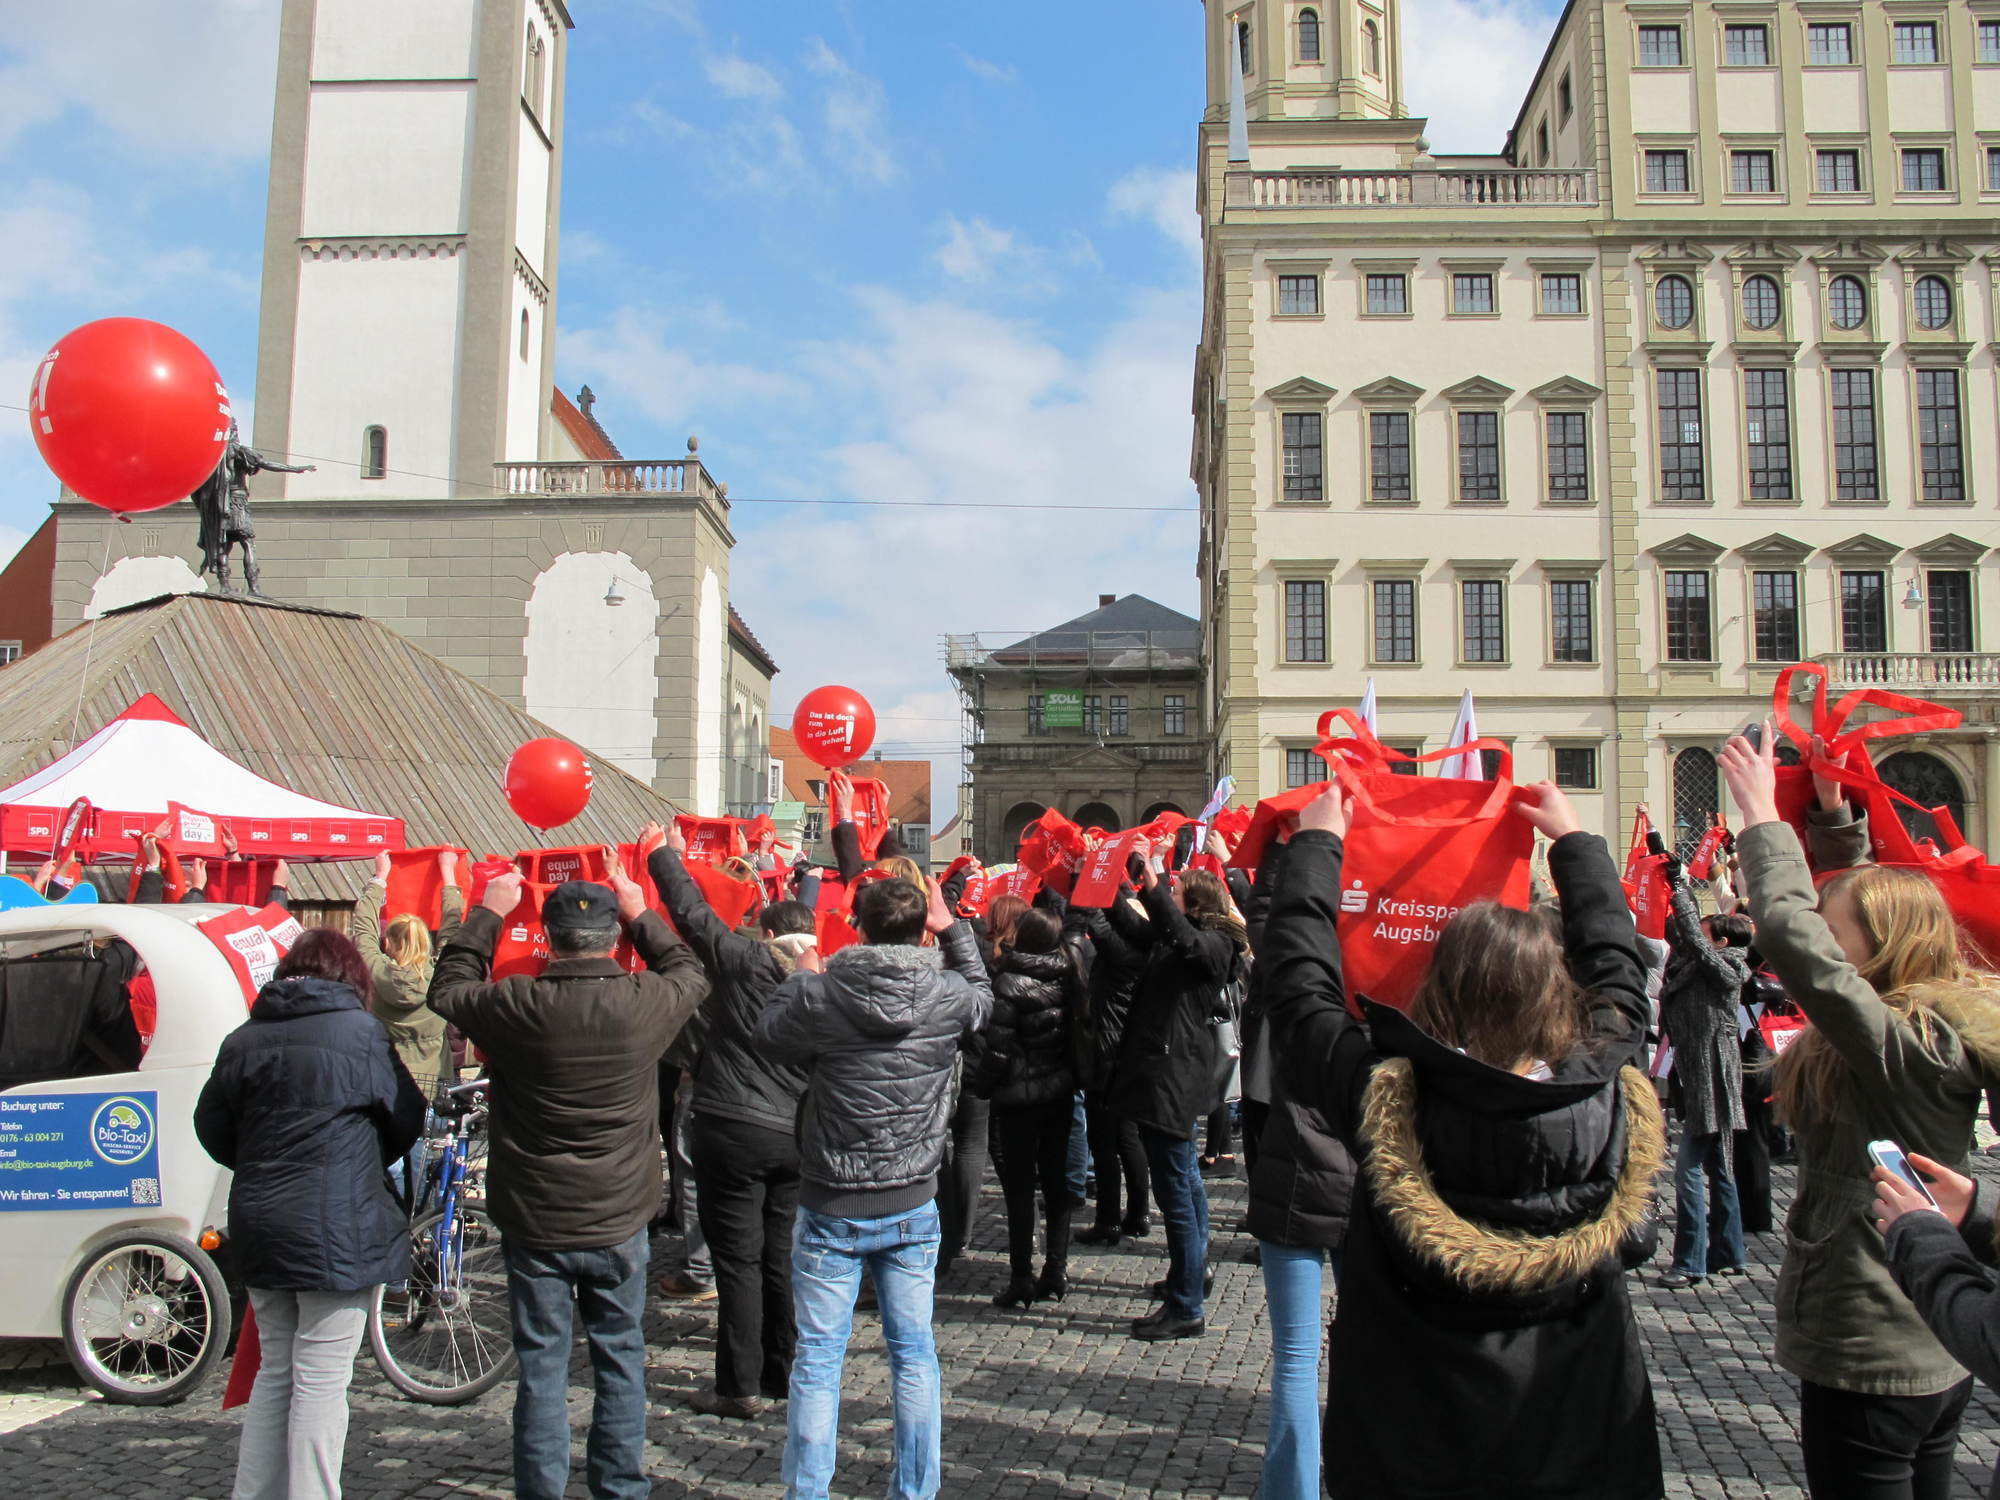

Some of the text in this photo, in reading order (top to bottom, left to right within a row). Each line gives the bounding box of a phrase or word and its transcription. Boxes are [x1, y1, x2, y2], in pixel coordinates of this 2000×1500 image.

[1047, 694, 1081, 704] SOLL
[829, 727, 845, 736] Luft
[30, 827, 50, 836] SPD
[252, 831, 269, 840] SPD
[292, 832, 309, 841] SPD
[330, 834, 347, 842] SPD
[367, 834, 384, 842] SPD
[547, 858, 580, 872] equal
[548, 870, 570, 883] pay
[1377, 897, 1459, 922] Kreisspa
[232, 928, 267, 950] equal
[246, 950, 267, 967] pay
[1, 1101, 65, 1113] Buchung unter:
[0, 1133, 18, 1142] 0176
[25, 1133, 34, 1142] 63
[35, 1132, 49, 1141] 004
[51, 1132, 64, 1141] 271
[98, 1127, 147, 1144] Bio-Taxi
[0, 1149, 17, 1157] Email
[0, 1190, 19, 1200] Wir
[21, 1189, 50, 1200] fahren
[57, 1189, 71, 1199] Sie
[73, 1187, 129, 1201] entspannen!
